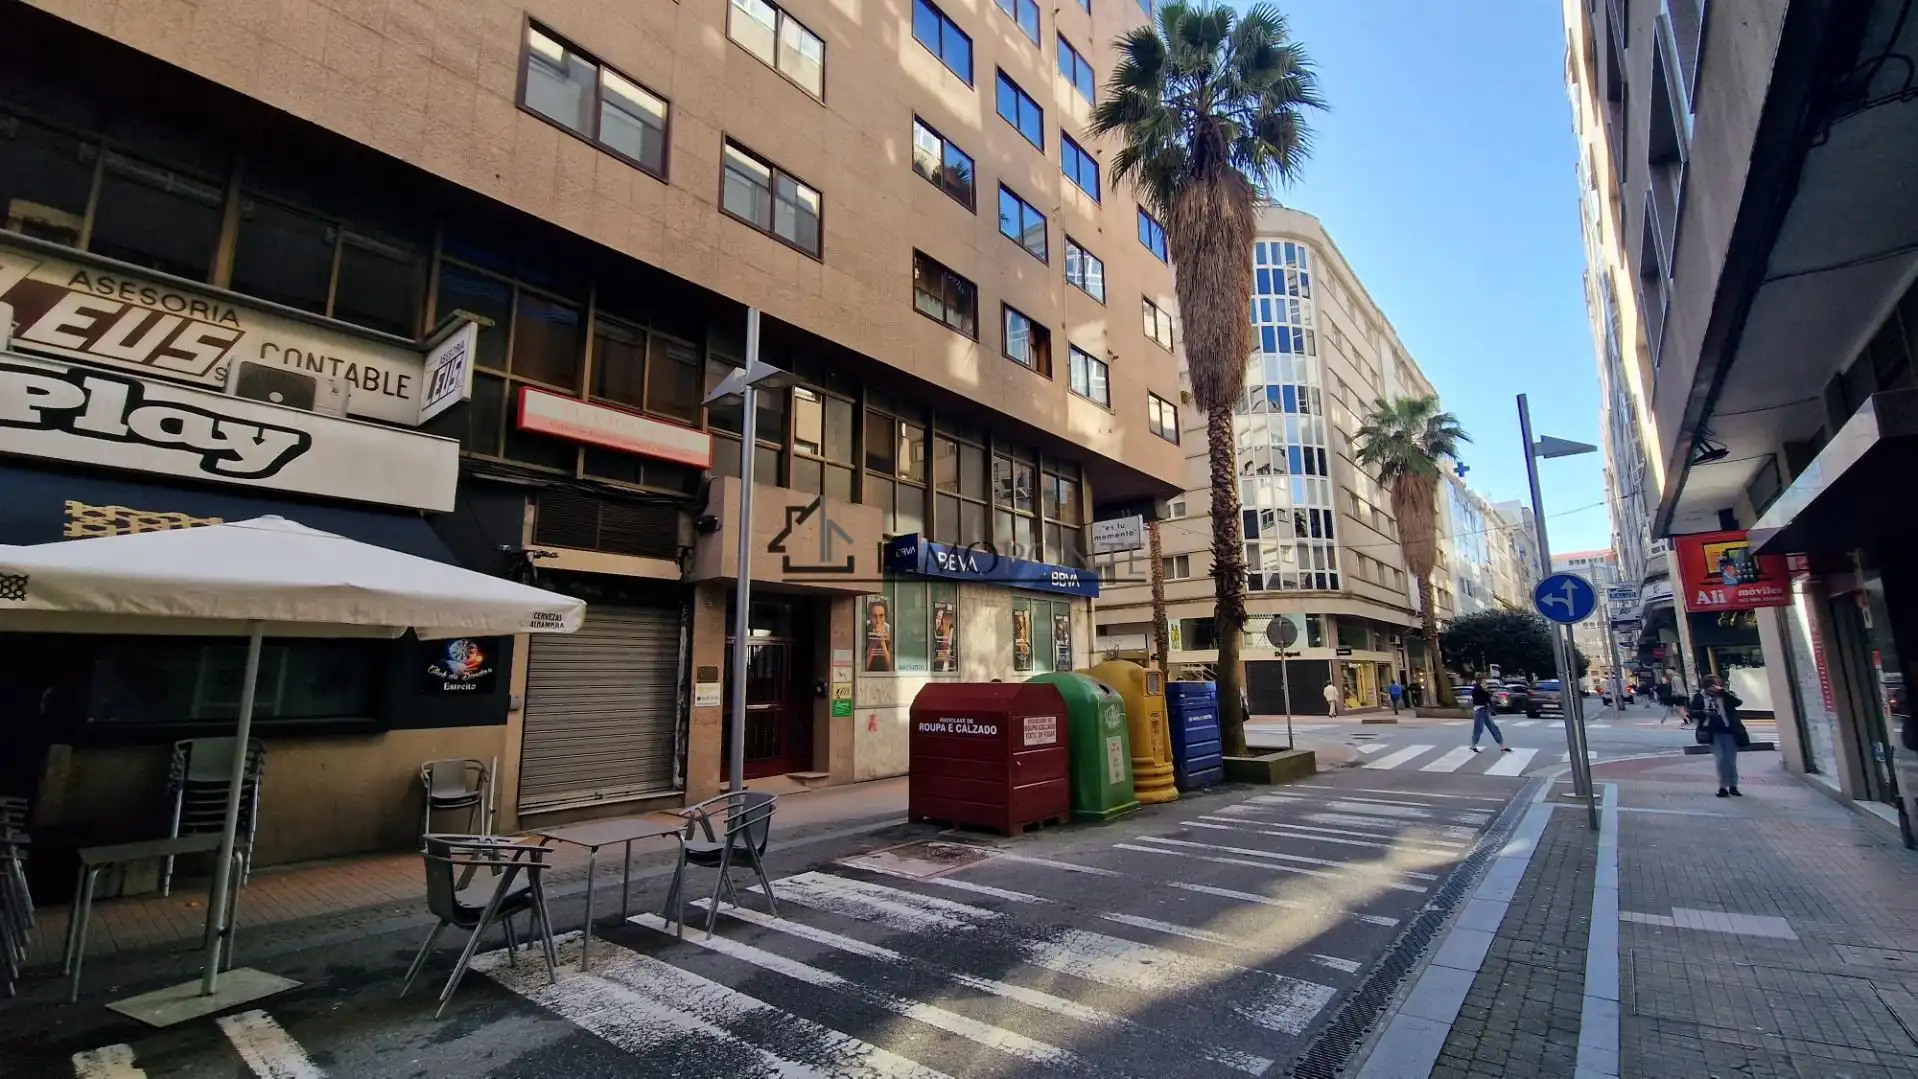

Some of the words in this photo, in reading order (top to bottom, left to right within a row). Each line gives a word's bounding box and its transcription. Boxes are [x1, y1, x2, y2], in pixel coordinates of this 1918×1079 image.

[68, 270, 240, 327] ASESORIA
[260, 342, 412, 400] CONTABLE
[0, 364, 310, 478] Play
[1051, 571, 1081, 588] BBVA
[1696, 590, 1728, 604] Ali
[533, 611, 562, 622] CERVEZAS
[529, 620, 565, 629] ALHAMBRA
[919, 722, 946, 732] ROUPA
[948, 723, 954, 732] E
[956, 724, 998, 735] CALZADO
